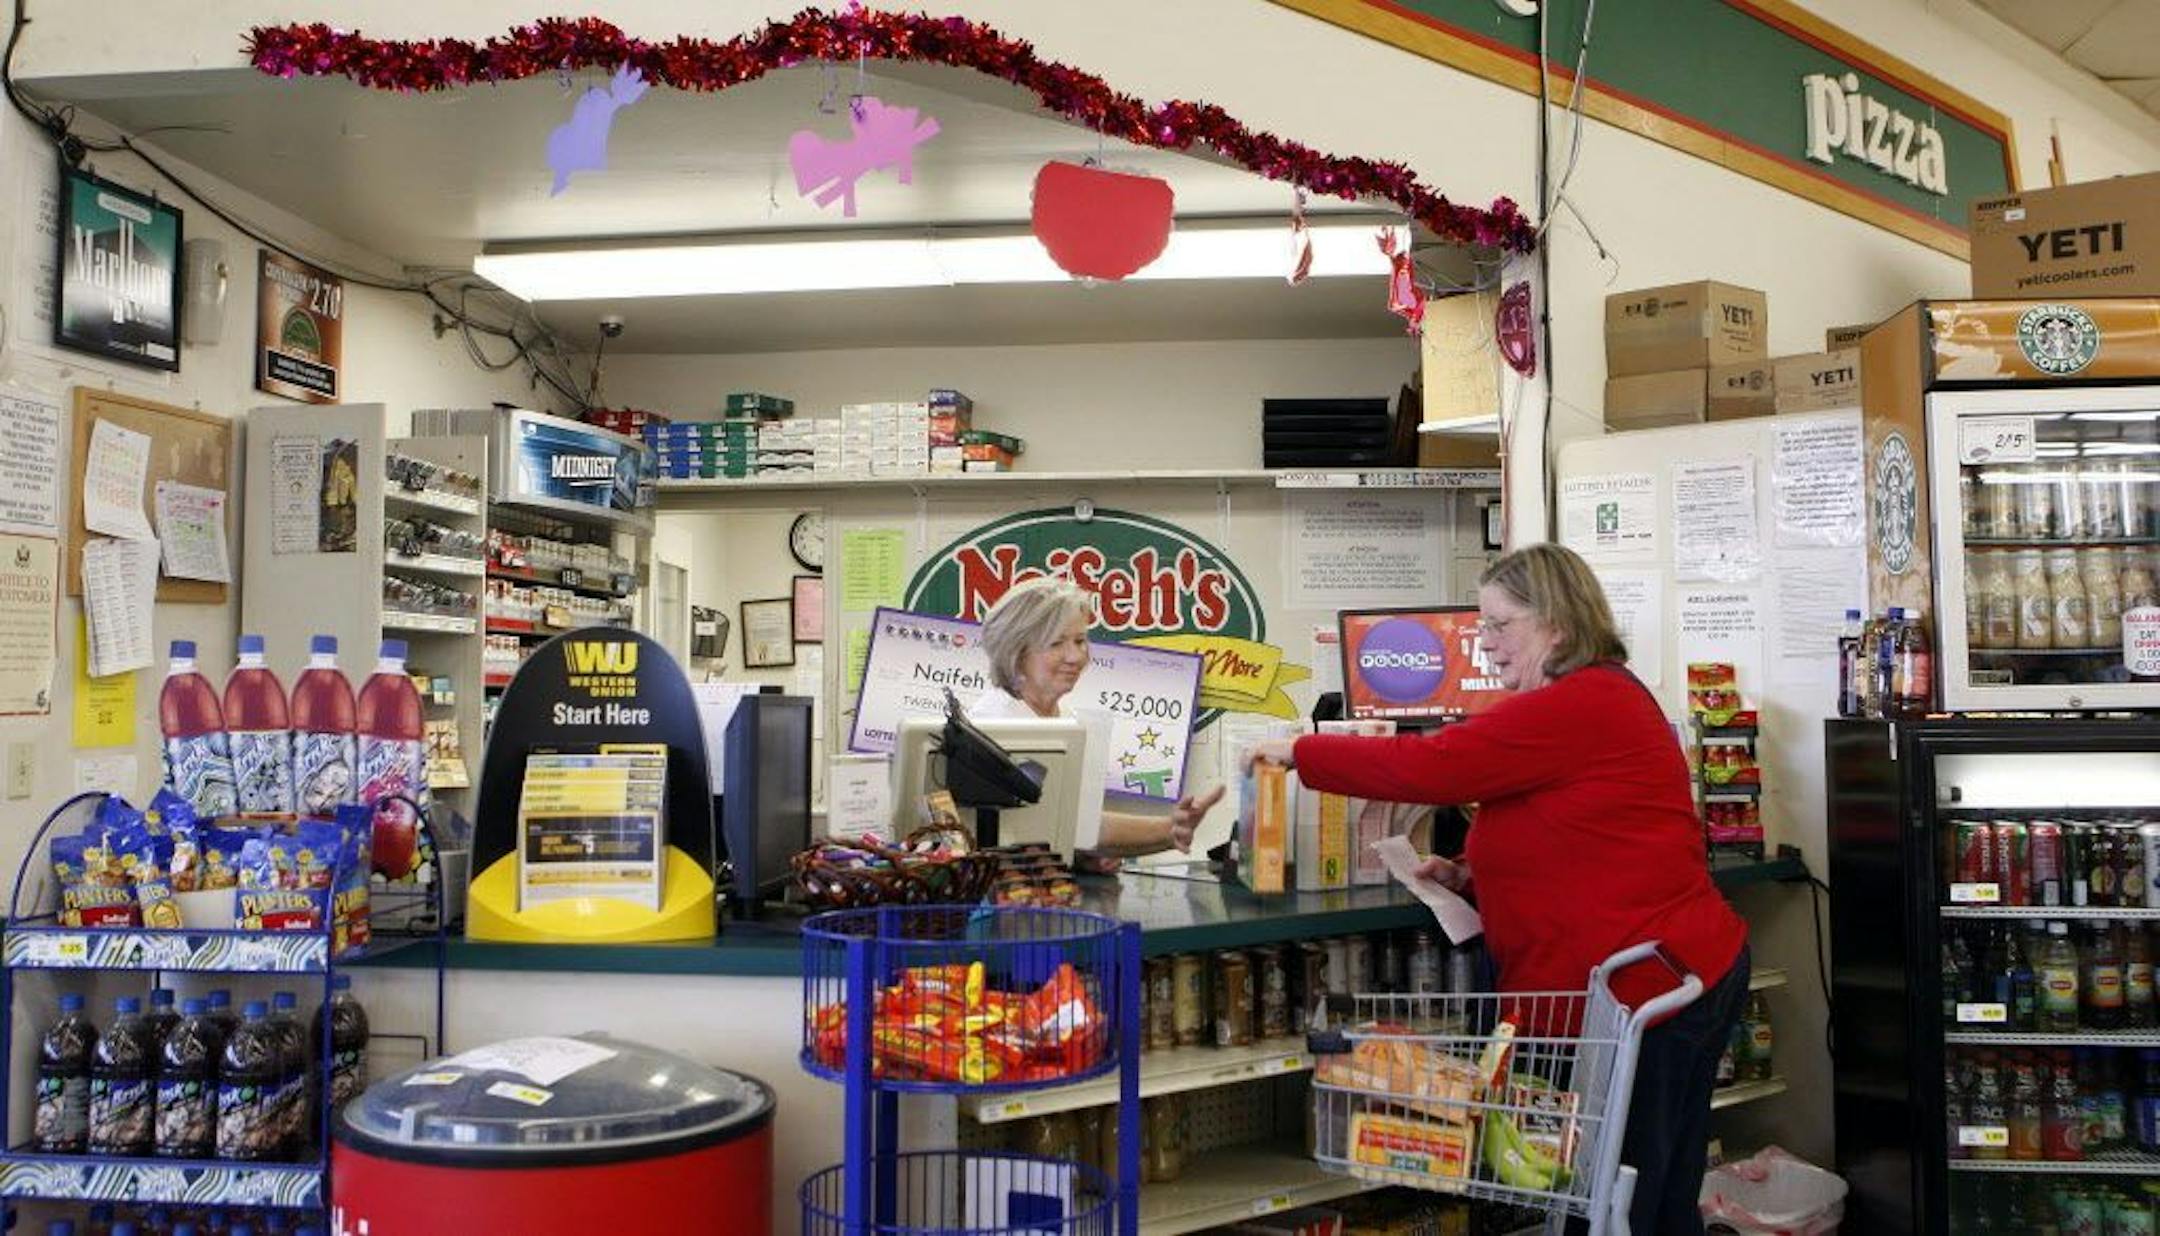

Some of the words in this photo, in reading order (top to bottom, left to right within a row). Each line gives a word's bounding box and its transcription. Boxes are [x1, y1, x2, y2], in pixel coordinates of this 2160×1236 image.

[1804, 72, 1948, 195] pizza
[2018, 221, 2124, 263] YETI
[2016, 263, 2135, 290] yeticoolers.com
[1721, 303, 1753, 324] YETI
[2019, 305, 2095, 335] STARBUCKS
[2032, 351, 2087, 373] COFFEE
[1810, 367, 1854, 386] YETI
[551, 454, 618, 479] MIDNIGHT
[953, 545, 1232, 630] Nfeh's
[563, 641, 638, 674] WU
[569, 676, 636, 688] WESTERN
[589, 687, 636, 698] UNION
[552, 701, 603, 726] Start
[605, 702, 650, 726] Here
[1098, 690, 1183, 720] $25,000
[864, 727, 898, 742] LOTTE
